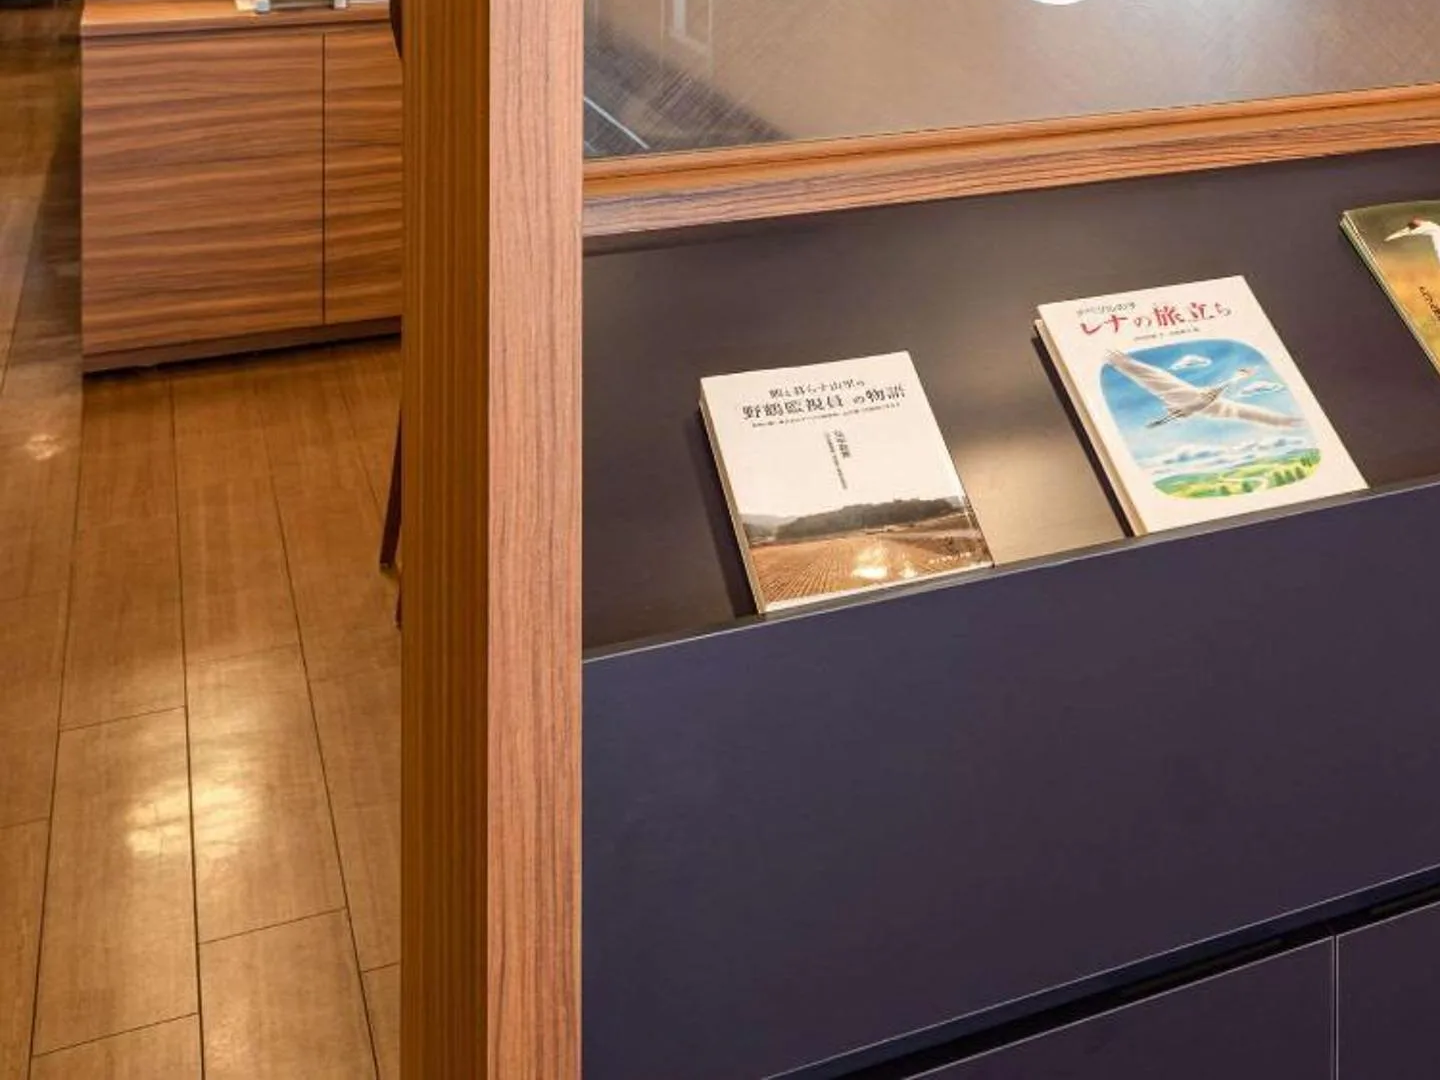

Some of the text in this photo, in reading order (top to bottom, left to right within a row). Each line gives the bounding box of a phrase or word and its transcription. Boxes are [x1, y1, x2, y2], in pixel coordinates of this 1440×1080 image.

[1079, 302, 1233, 336] レナの旅立ち
